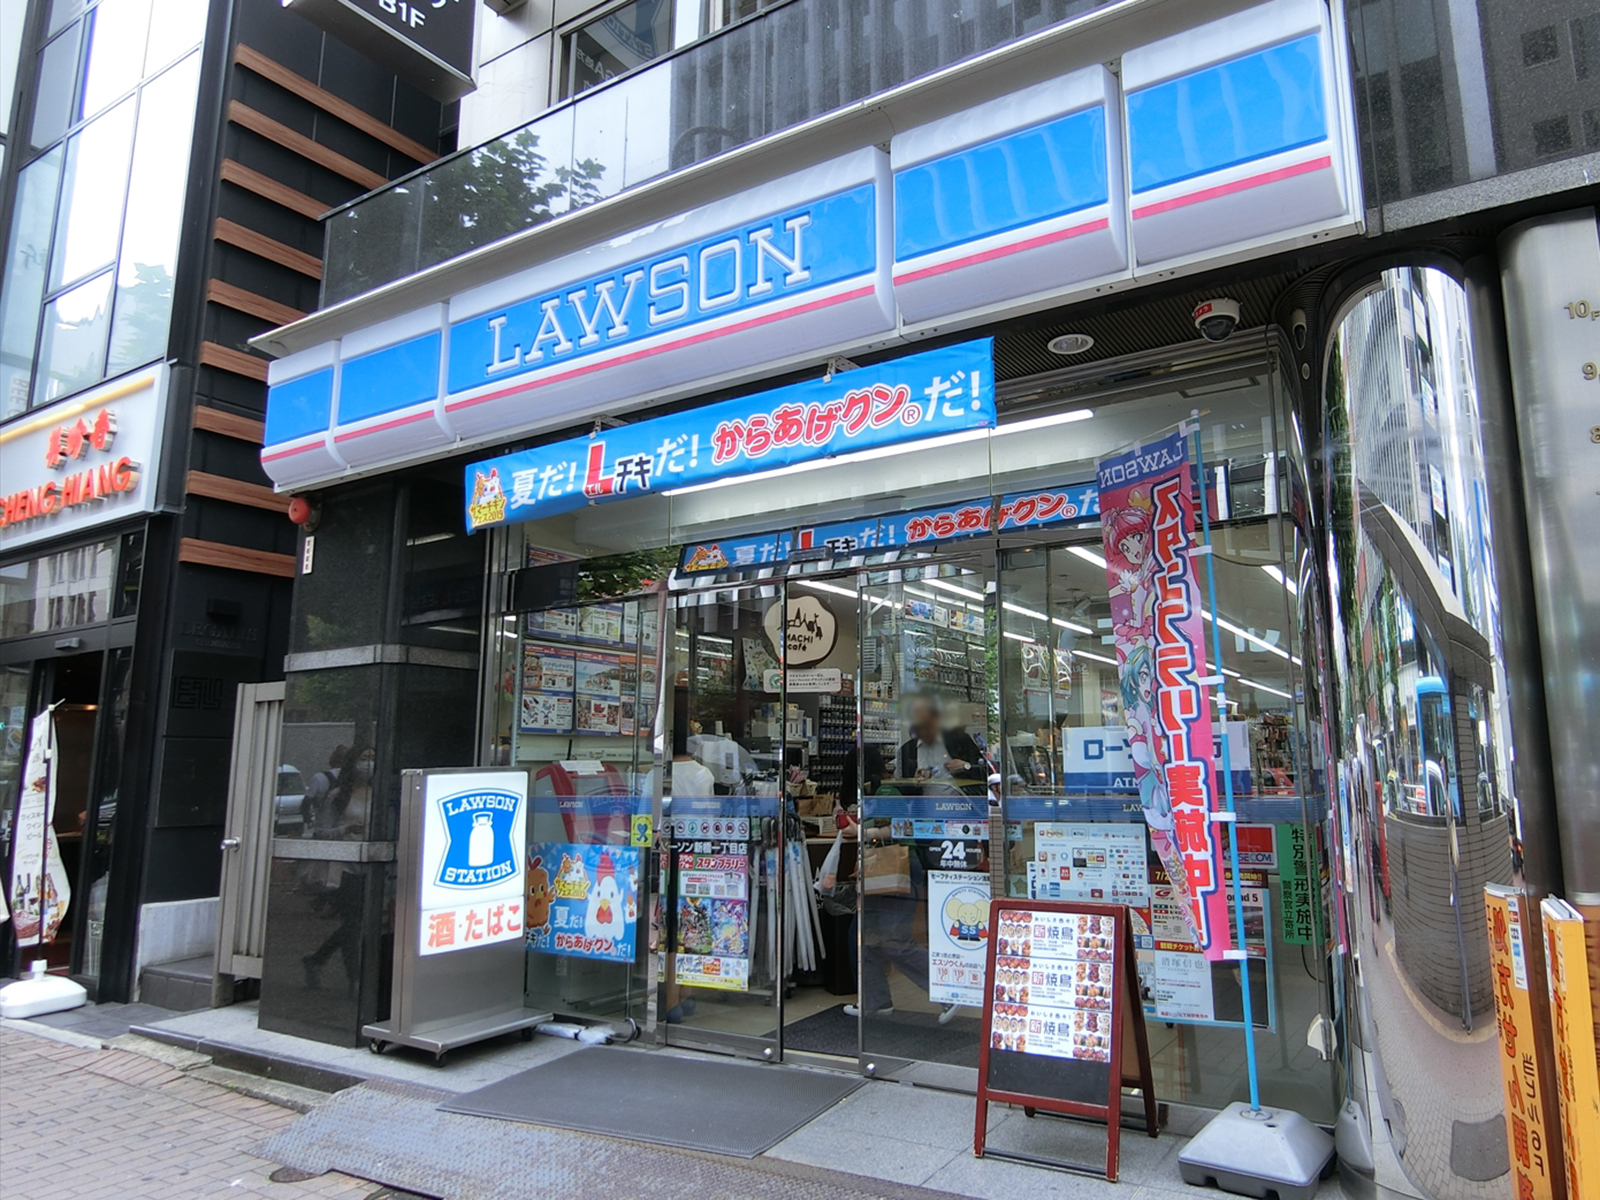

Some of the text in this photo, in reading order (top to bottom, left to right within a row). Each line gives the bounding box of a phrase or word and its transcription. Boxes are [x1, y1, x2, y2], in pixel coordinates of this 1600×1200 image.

[486, 213, 813, 377] LAWSON
[61, 456, 132, 508] HIANG
[510, 462, 578, 510] 夏だ!
[446, 795, 516, 818] LAWSON
[935, 803, 973, 811] LAWSON
[941, 840, 967, 860] 24
[1237, 853, 1272, 862] SECOM
[444, 860, 513, 884] STATION
[940, 860, 968, 868] 年中無休
[1252, 894, 1259, 903] 5
[428, 904, 521, 948] 酒・たばこ
[554, 906, 583, 928] 夏だ!
[961, 926, 977, 935] SS
